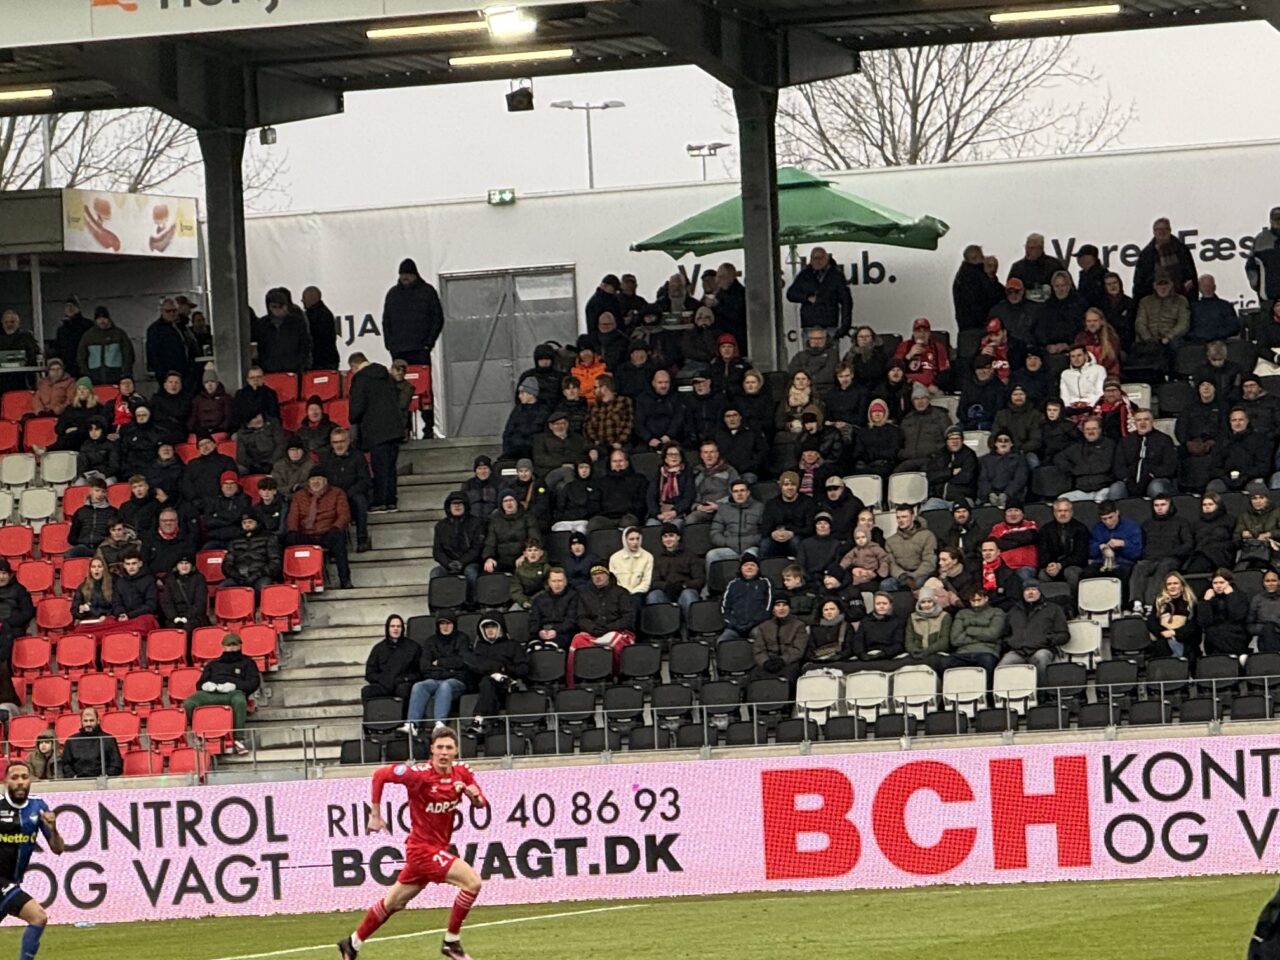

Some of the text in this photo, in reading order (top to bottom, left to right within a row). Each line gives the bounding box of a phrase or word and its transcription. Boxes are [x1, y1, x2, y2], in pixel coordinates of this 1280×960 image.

[1102, 748, 1280, 804] KONT
[33, 795, 289, 853] ONTROL
[506, 793, 556, 829] 40
[571, 789, 620, 826] 86
[634, 787, 681, 823] 93
[761, 755, 1092, 880] BCH
[433, 849, 453, 867] 21
[1104, 811, 1209, 865] OG
[23, 852, 290, 910] OG VAGT
